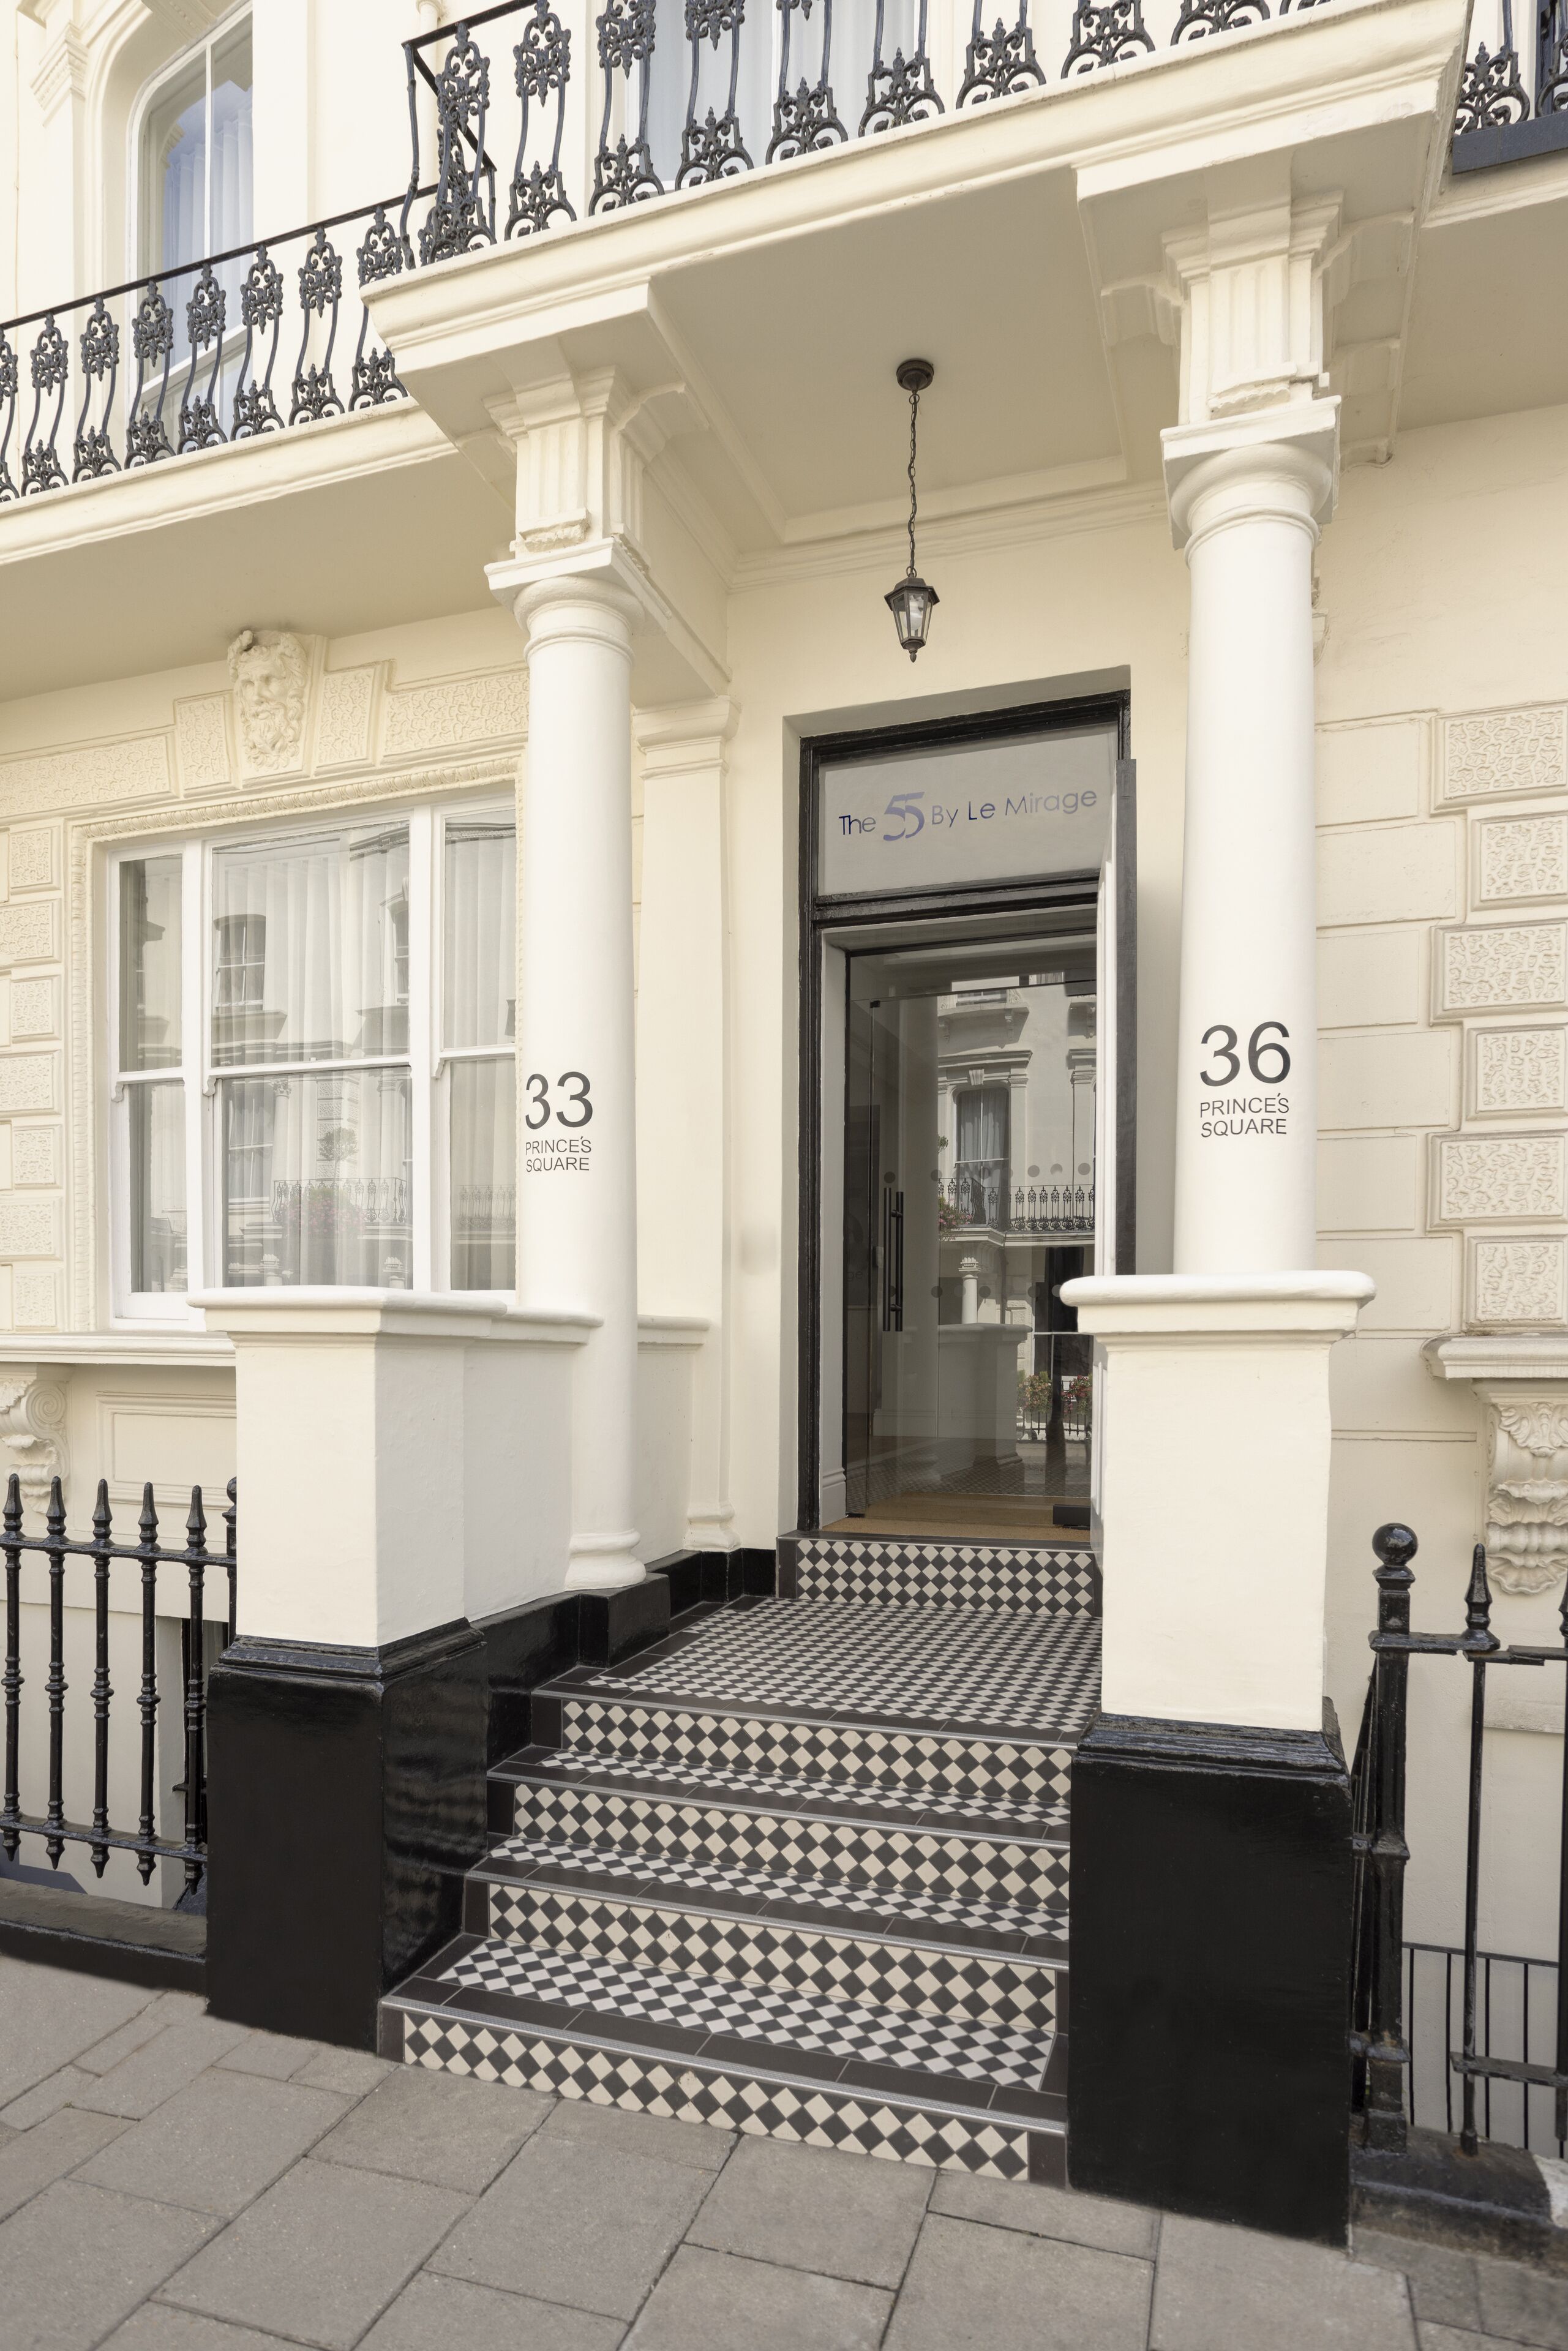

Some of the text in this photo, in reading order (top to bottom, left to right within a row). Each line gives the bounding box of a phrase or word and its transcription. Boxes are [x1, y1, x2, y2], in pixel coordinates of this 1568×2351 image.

[838, 790, 1097, 841] The 55 By Le Mirage
[1199, 1021, 1291, 1087] 36
[525, 1071, 593, 1130] 33
[1200, 1092, 1289, 1118] PRINCE'S
[1201, 1118, 1288, 1138] SQUARE
[525, 1136, 592, 1156] PRINCE'S
[526, 1157, 590, 1173] SQUARE
